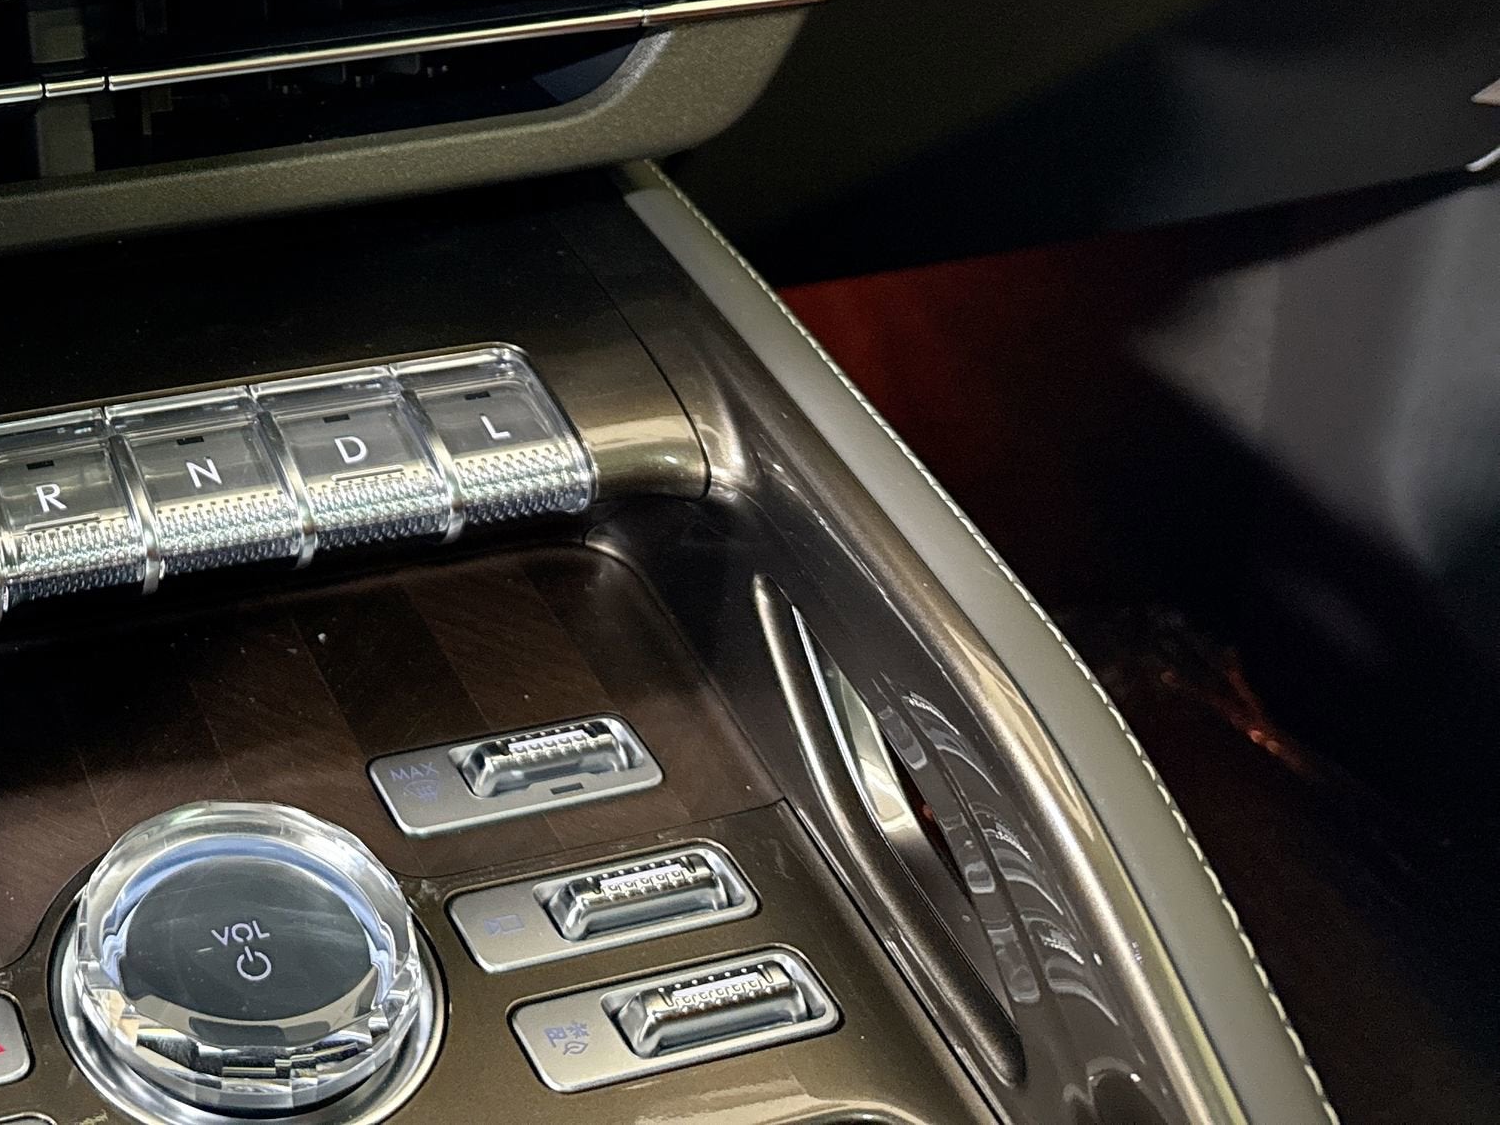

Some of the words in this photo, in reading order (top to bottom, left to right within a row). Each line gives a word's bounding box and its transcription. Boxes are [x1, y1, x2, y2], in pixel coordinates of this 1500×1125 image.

[479, 413, 511, 441] L
[334, 435, 368, 465] D
[186, 457, 223, 488] N
[35, 482, 67, 513] R
[390, 761, 439, 781] MAX
[211, 920, 270, 947] VOL
